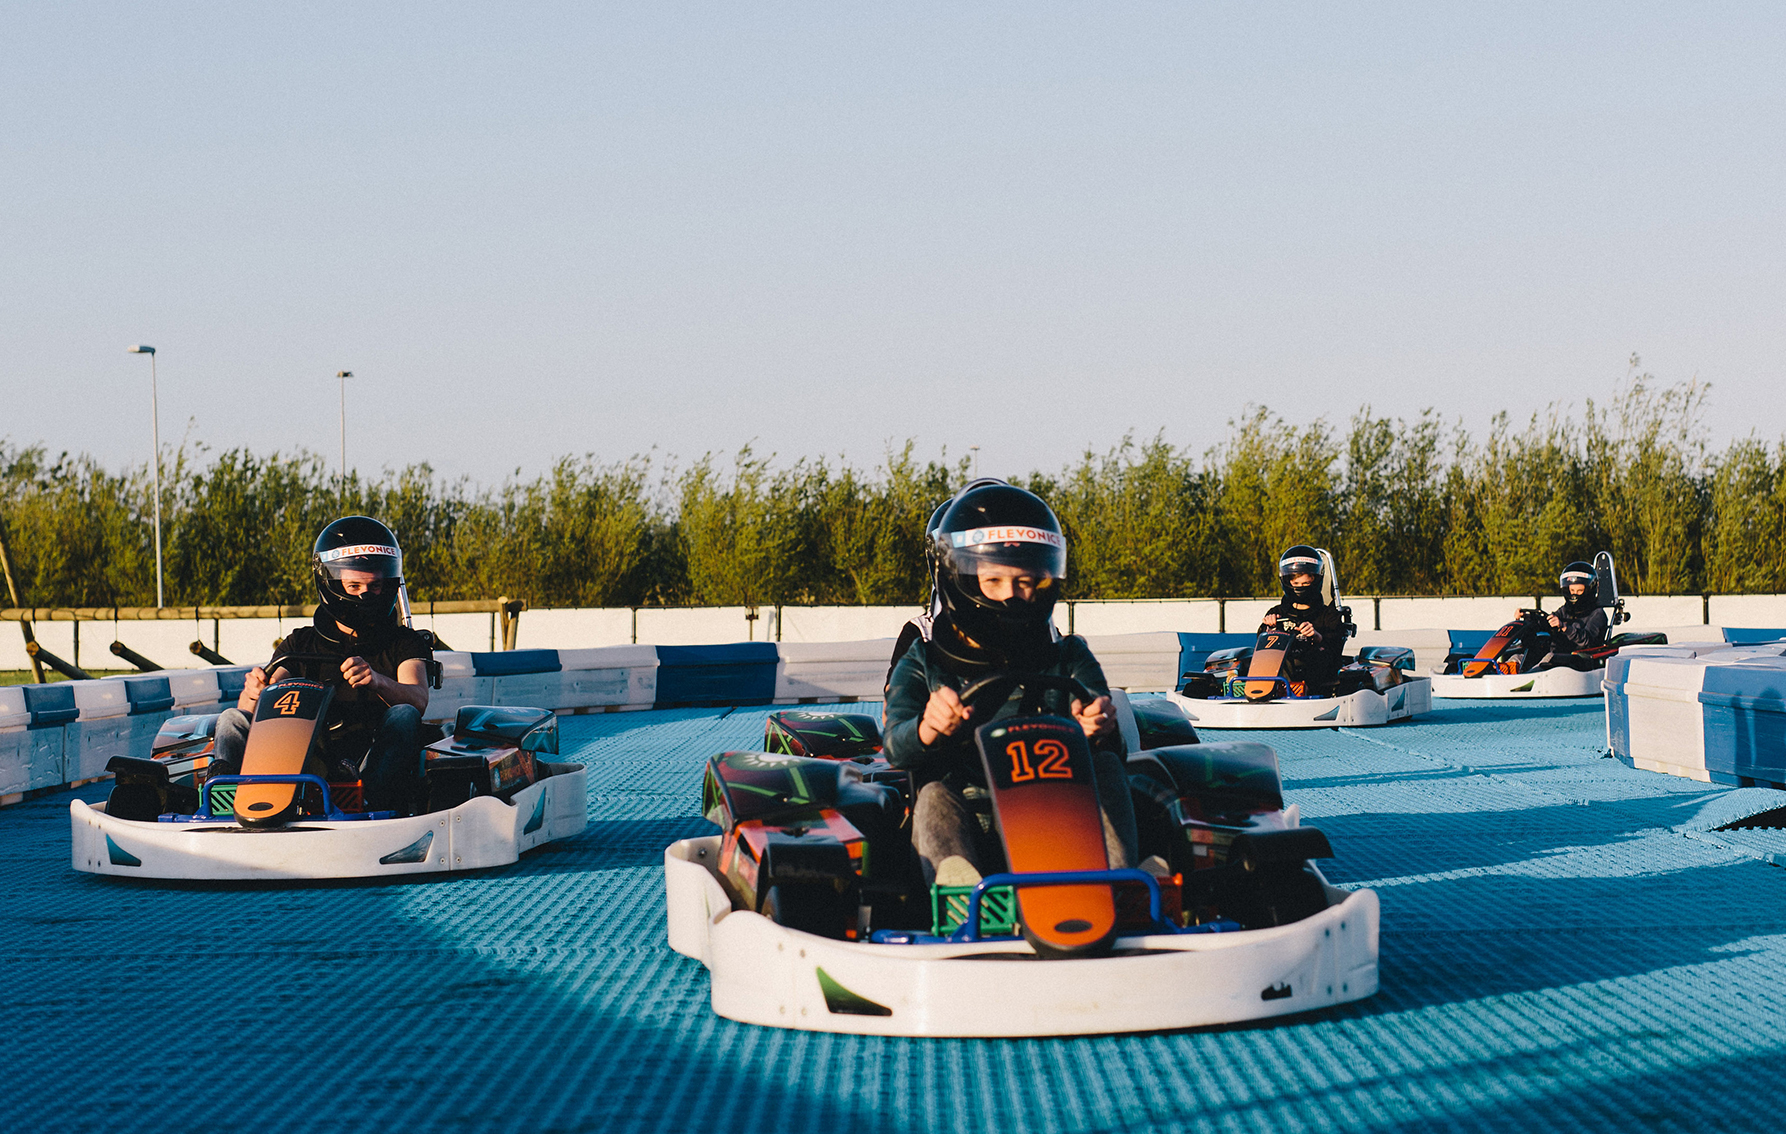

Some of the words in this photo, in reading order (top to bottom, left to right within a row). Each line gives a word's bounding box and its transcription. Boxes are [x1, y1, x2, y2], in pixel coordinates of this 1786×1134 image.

[988, 529, 1061, 546] FLEVONICE
[341, 545, 396, 557] FLEVONICE
[1265, 636, 1279, 649] 7
[273, 691, 300, 715] 4
[1006, 739, 1073, 783] 12
